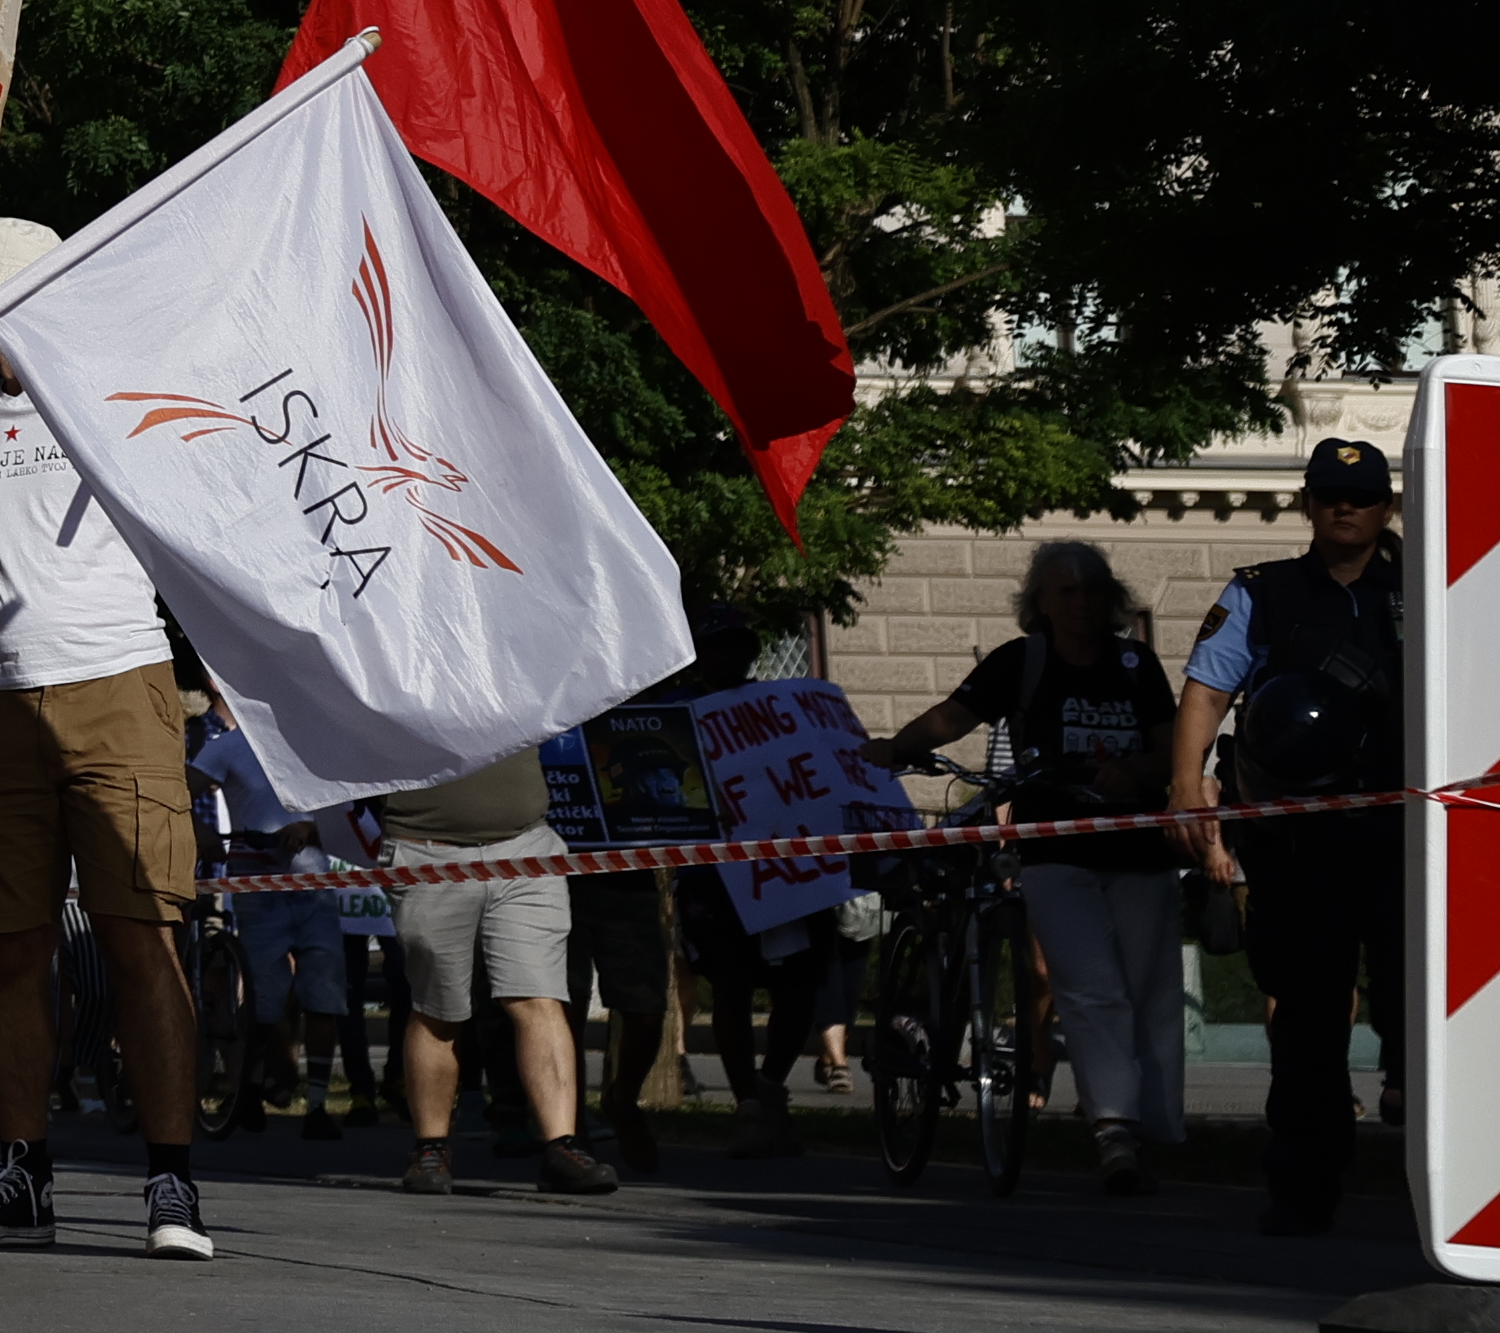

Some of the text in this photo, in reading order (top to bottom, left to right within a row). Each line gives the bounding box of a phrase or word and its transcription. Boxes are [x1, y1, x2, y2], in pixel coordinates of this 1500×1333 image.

[0, 448, 25, 467] JE
[239, 367, 391, 598] ISKRA
[1062, 696, 1135, 713] ALAN
[609, 715, 663, 732] NATO
[1062, 711, 1140, 728] FORD
[766, 752, 831, 806] WE
